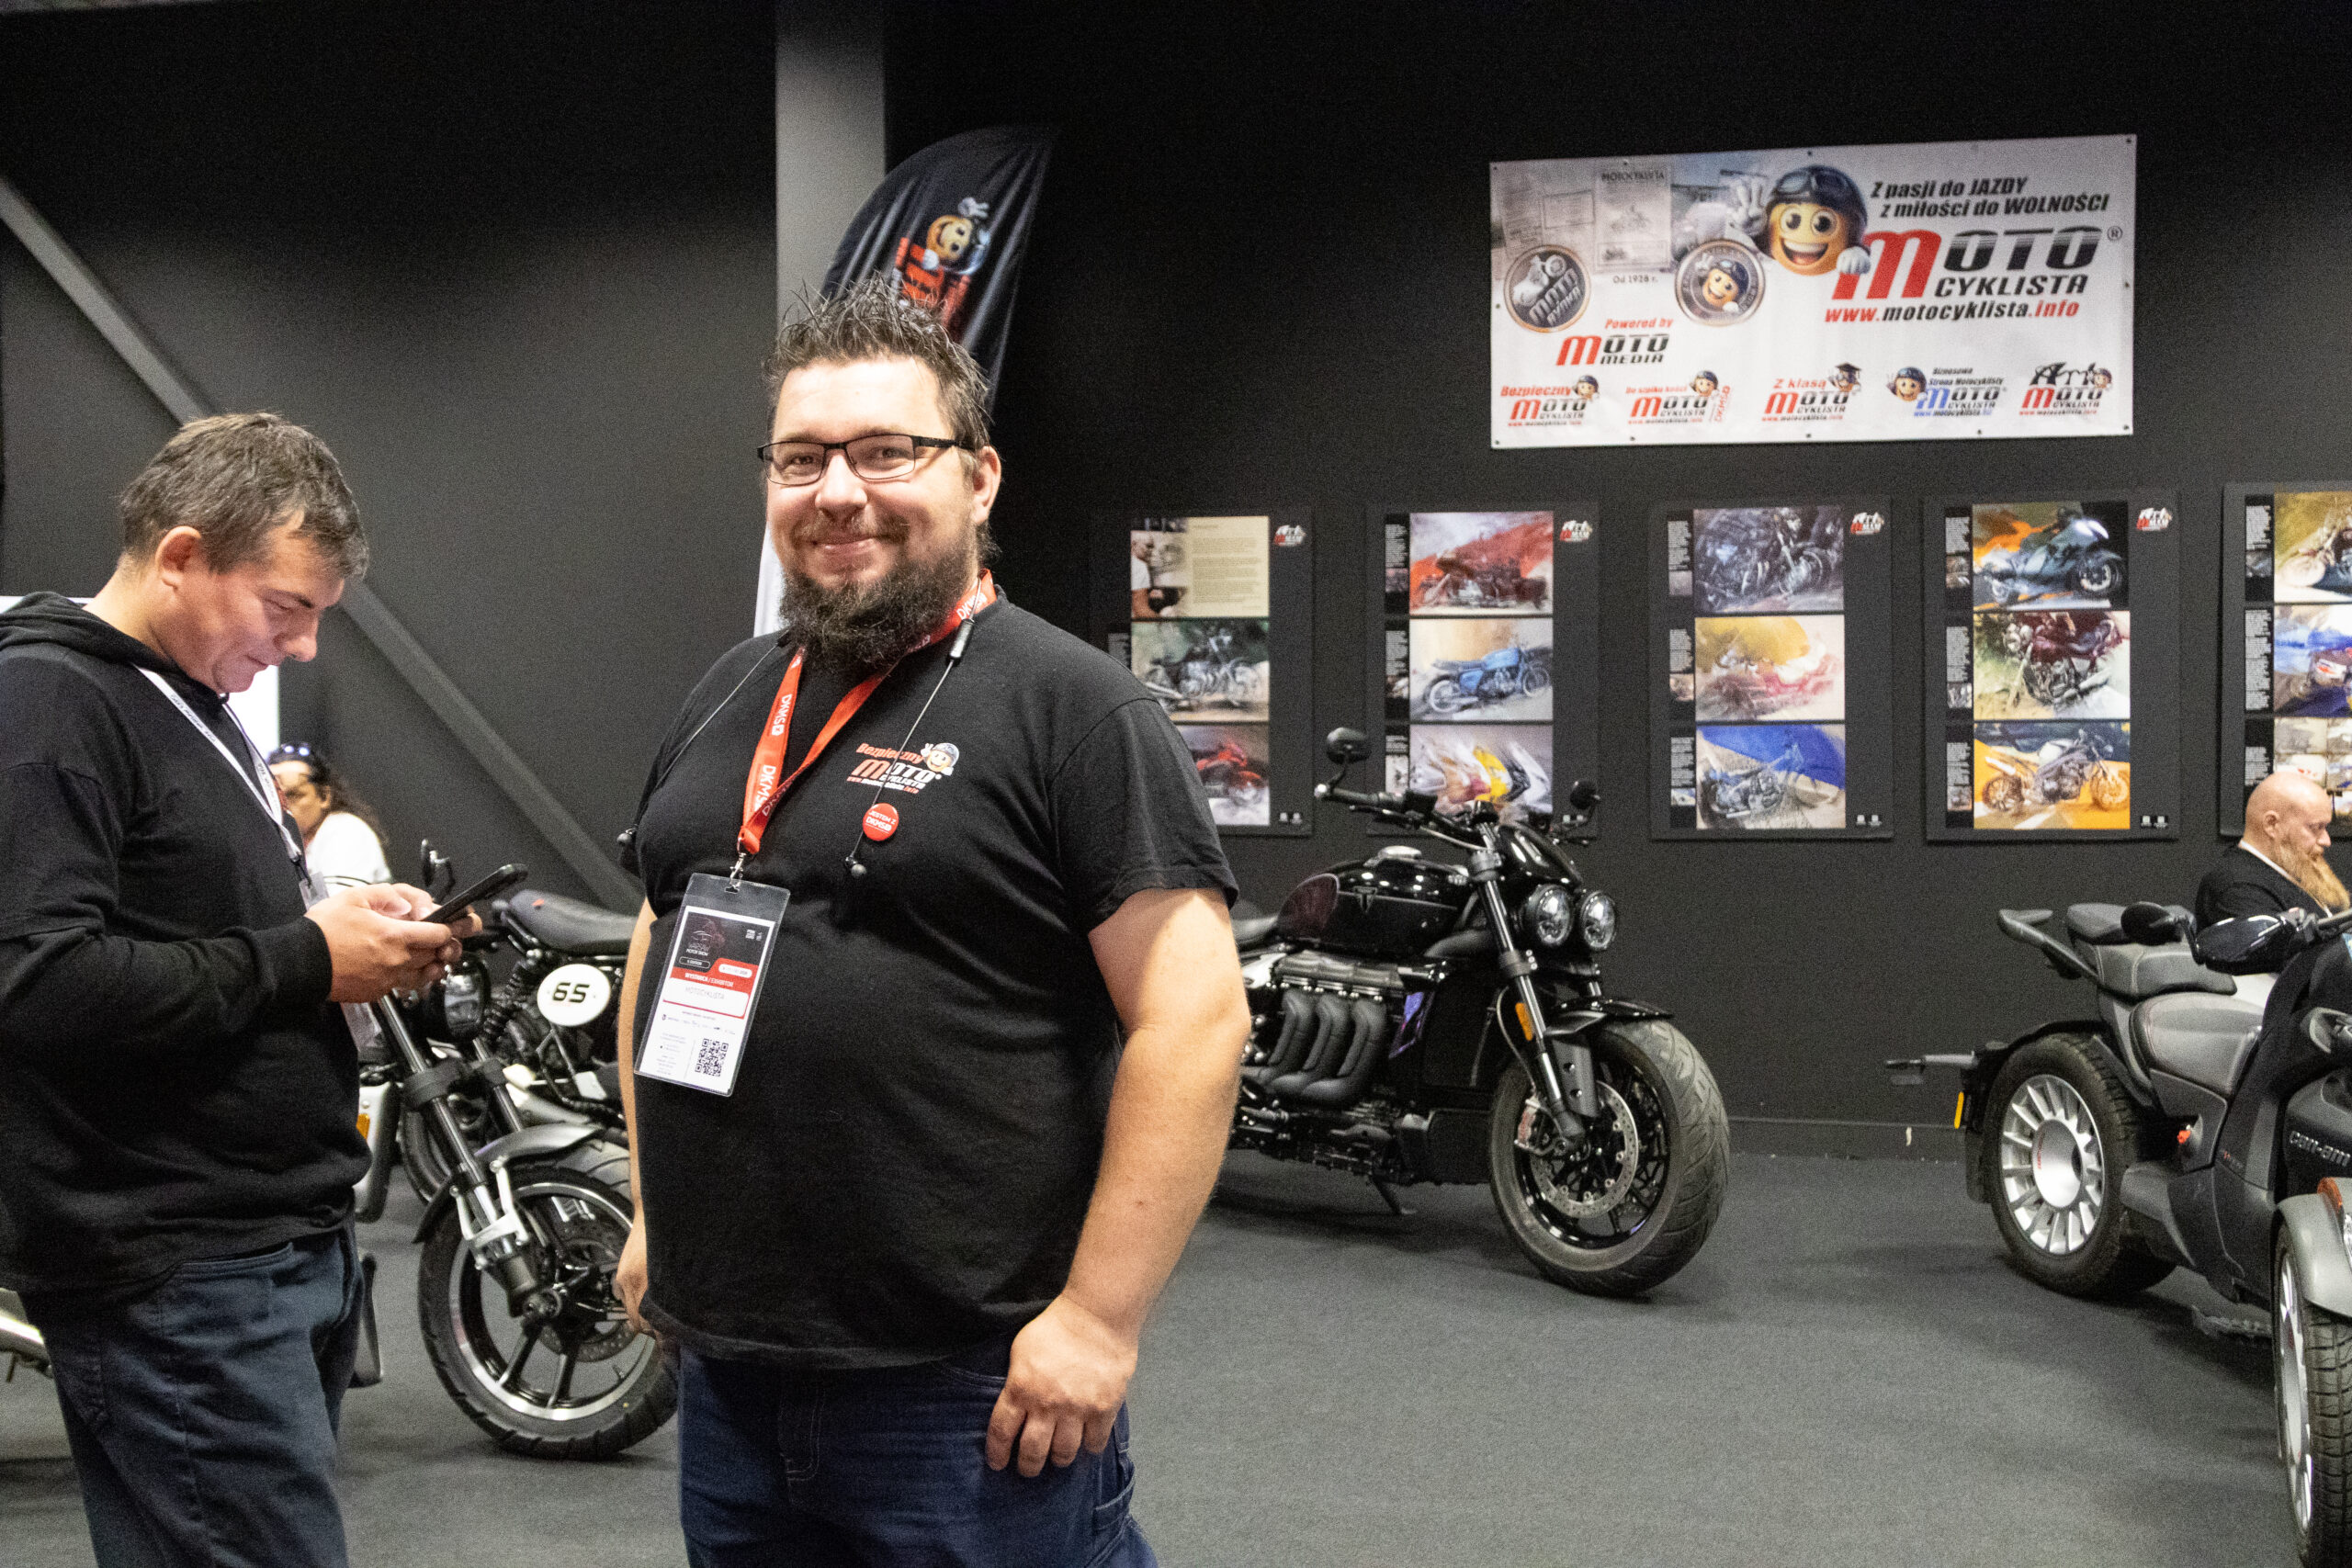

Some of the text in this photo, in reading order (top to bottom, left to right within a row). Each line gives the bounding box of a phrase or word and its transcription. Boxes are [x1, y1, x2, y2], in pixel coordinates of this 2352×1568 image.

[1885, 180, 1938, 200] pasji
[1939, 180, 1965, 197] do
[1968, 176, 2029, 197] JAZDY
[1894, 198, 1970, 218] miłości
[1973, 198, 1999, 216] do
[2004, 192, 2110, 216] WOLNOŚCI
[1832, 225, 2103, 300] MOTO
[1935, 275, 2088, 298] CYKLISTA
[1825, 300, 2080, 322] www.motocyklista.info
[1605, 318, 1674, 329] Powered by
[1555, 333, 1670, 367] MOTO
[1600, 355, 1664, 365] MEDIA
[1500, 385, 1572, 397] Bezpieczny
[1787, 377, 1826, 390] klasą
[1510, 398, 1588, 420] MOTO
[1630, 395, 1708, 418] MOTO
[1764, 390, 1849, 414] MOTO
[1916, 386, 2000, 410] MOTO
[2021, 387, 2102, 409] MOTO
[773, 694, 793, 725] DKMS
[855, 742, 924, 765] Bezpieczny
[851, 759, 936, 784] MOTO
[552, 982, 590, 1004] 65
